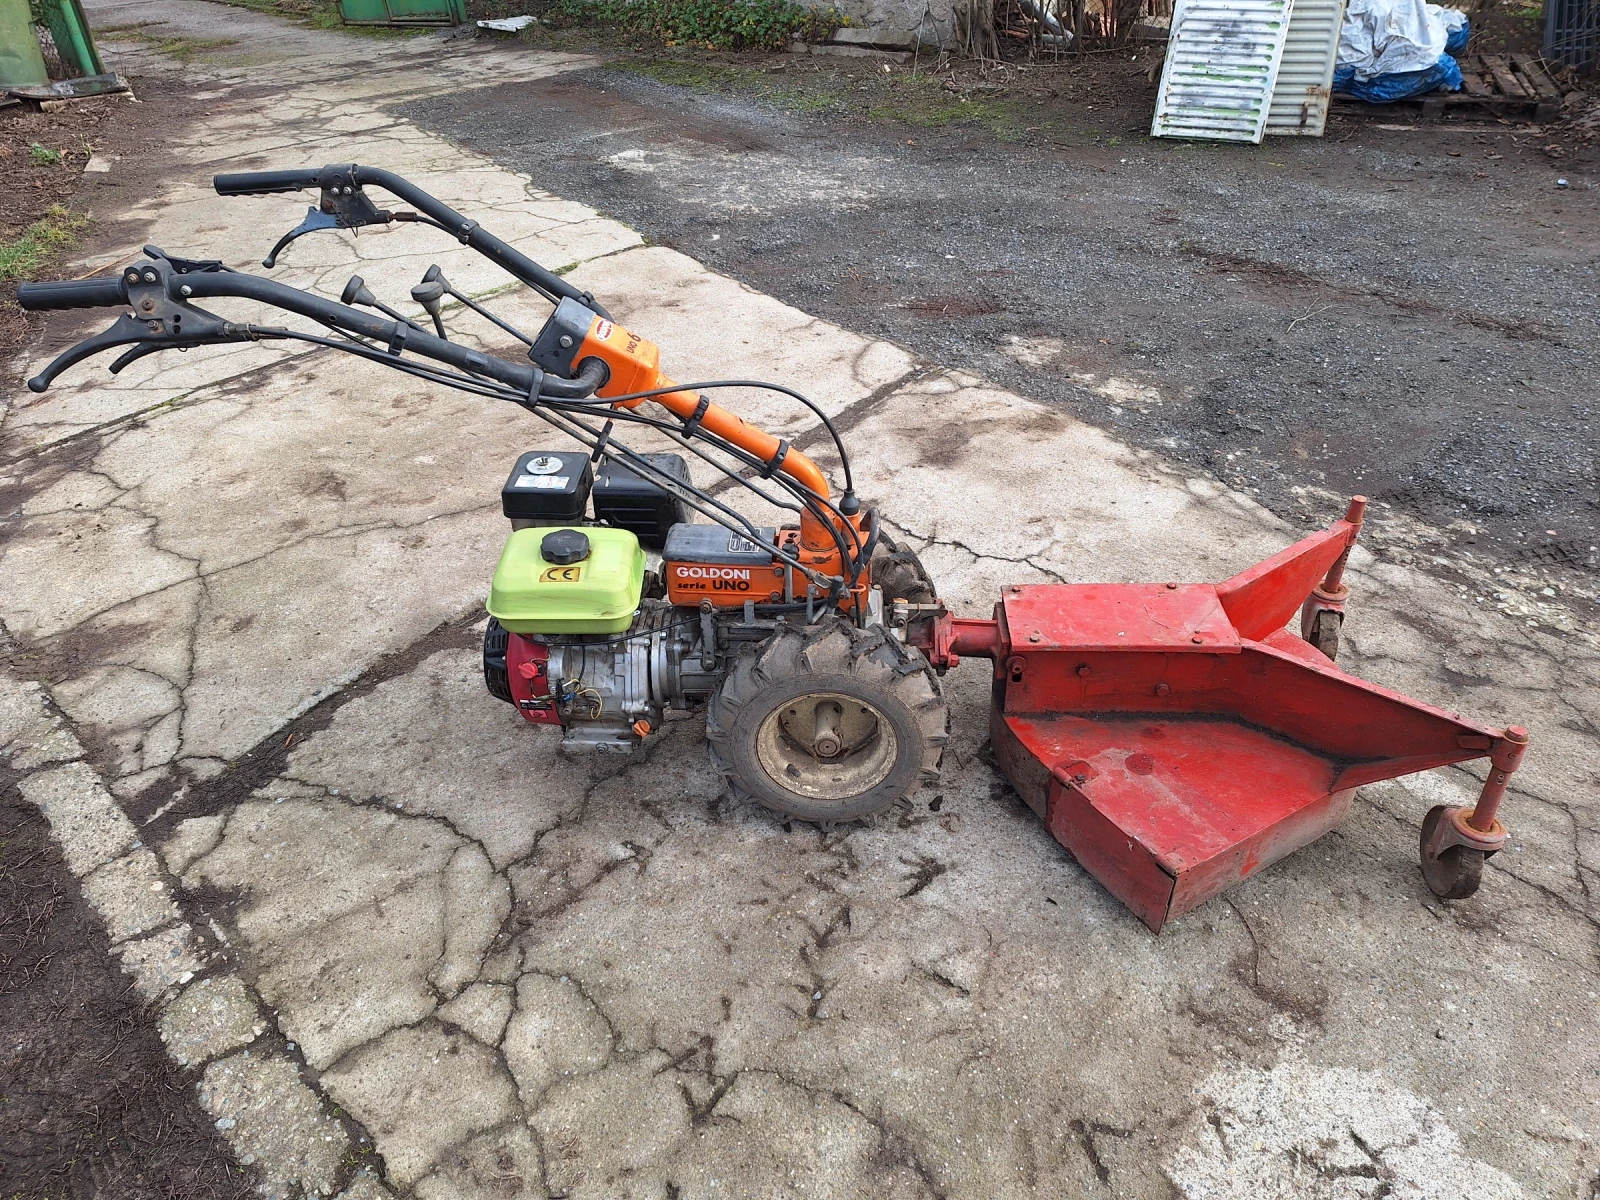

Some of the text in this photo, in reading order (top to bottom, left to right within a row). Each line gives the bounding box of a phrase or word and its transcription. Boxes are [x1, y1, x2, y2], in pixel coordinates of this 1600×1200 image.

[626, 332, 641, 353] UNO 6
[547, 568, 573, 581] CE
[676, 567, 750, 580] GOLDONI
[677, 580, 750, 591] serie UNO
